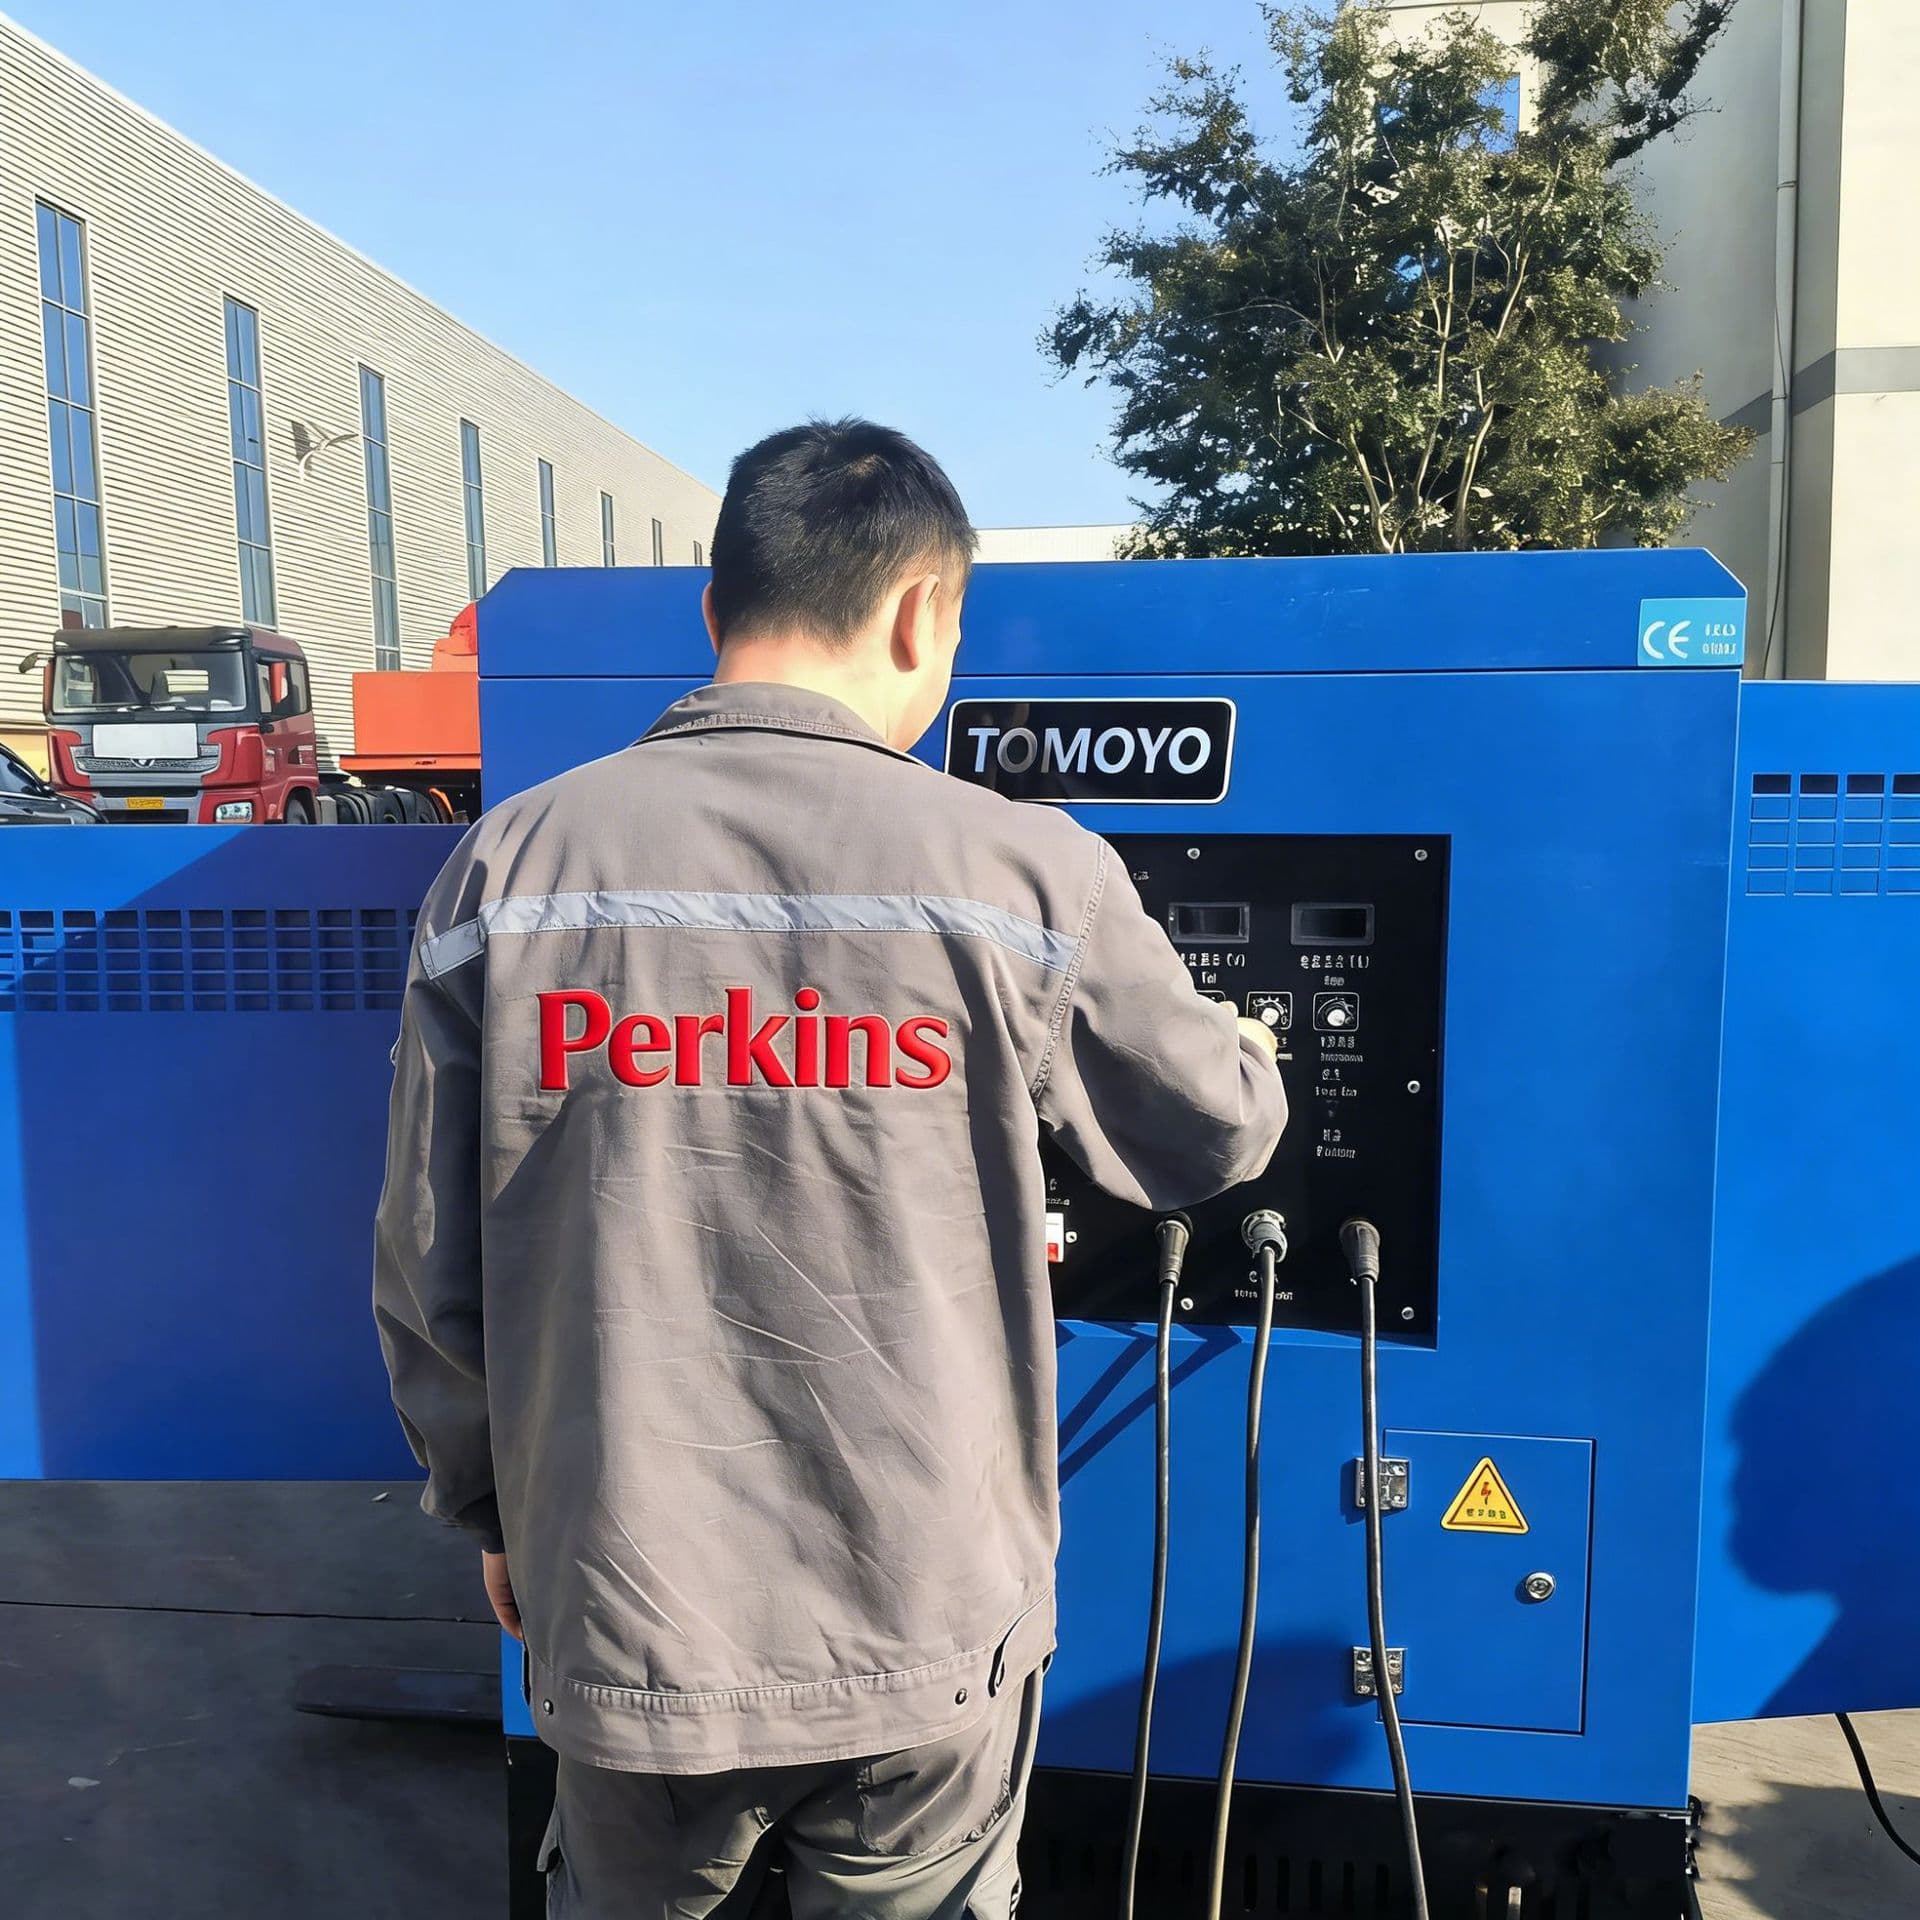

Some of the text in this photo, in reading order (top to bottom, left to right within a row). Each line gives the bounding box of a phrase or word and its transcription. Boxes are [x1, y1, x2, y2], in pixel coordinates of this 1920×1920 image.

[1643, 620, 1691, 659] CE
[967, 726, 1212, 775] TOMOYO
[535, 986, 953, 1092] Perkins
